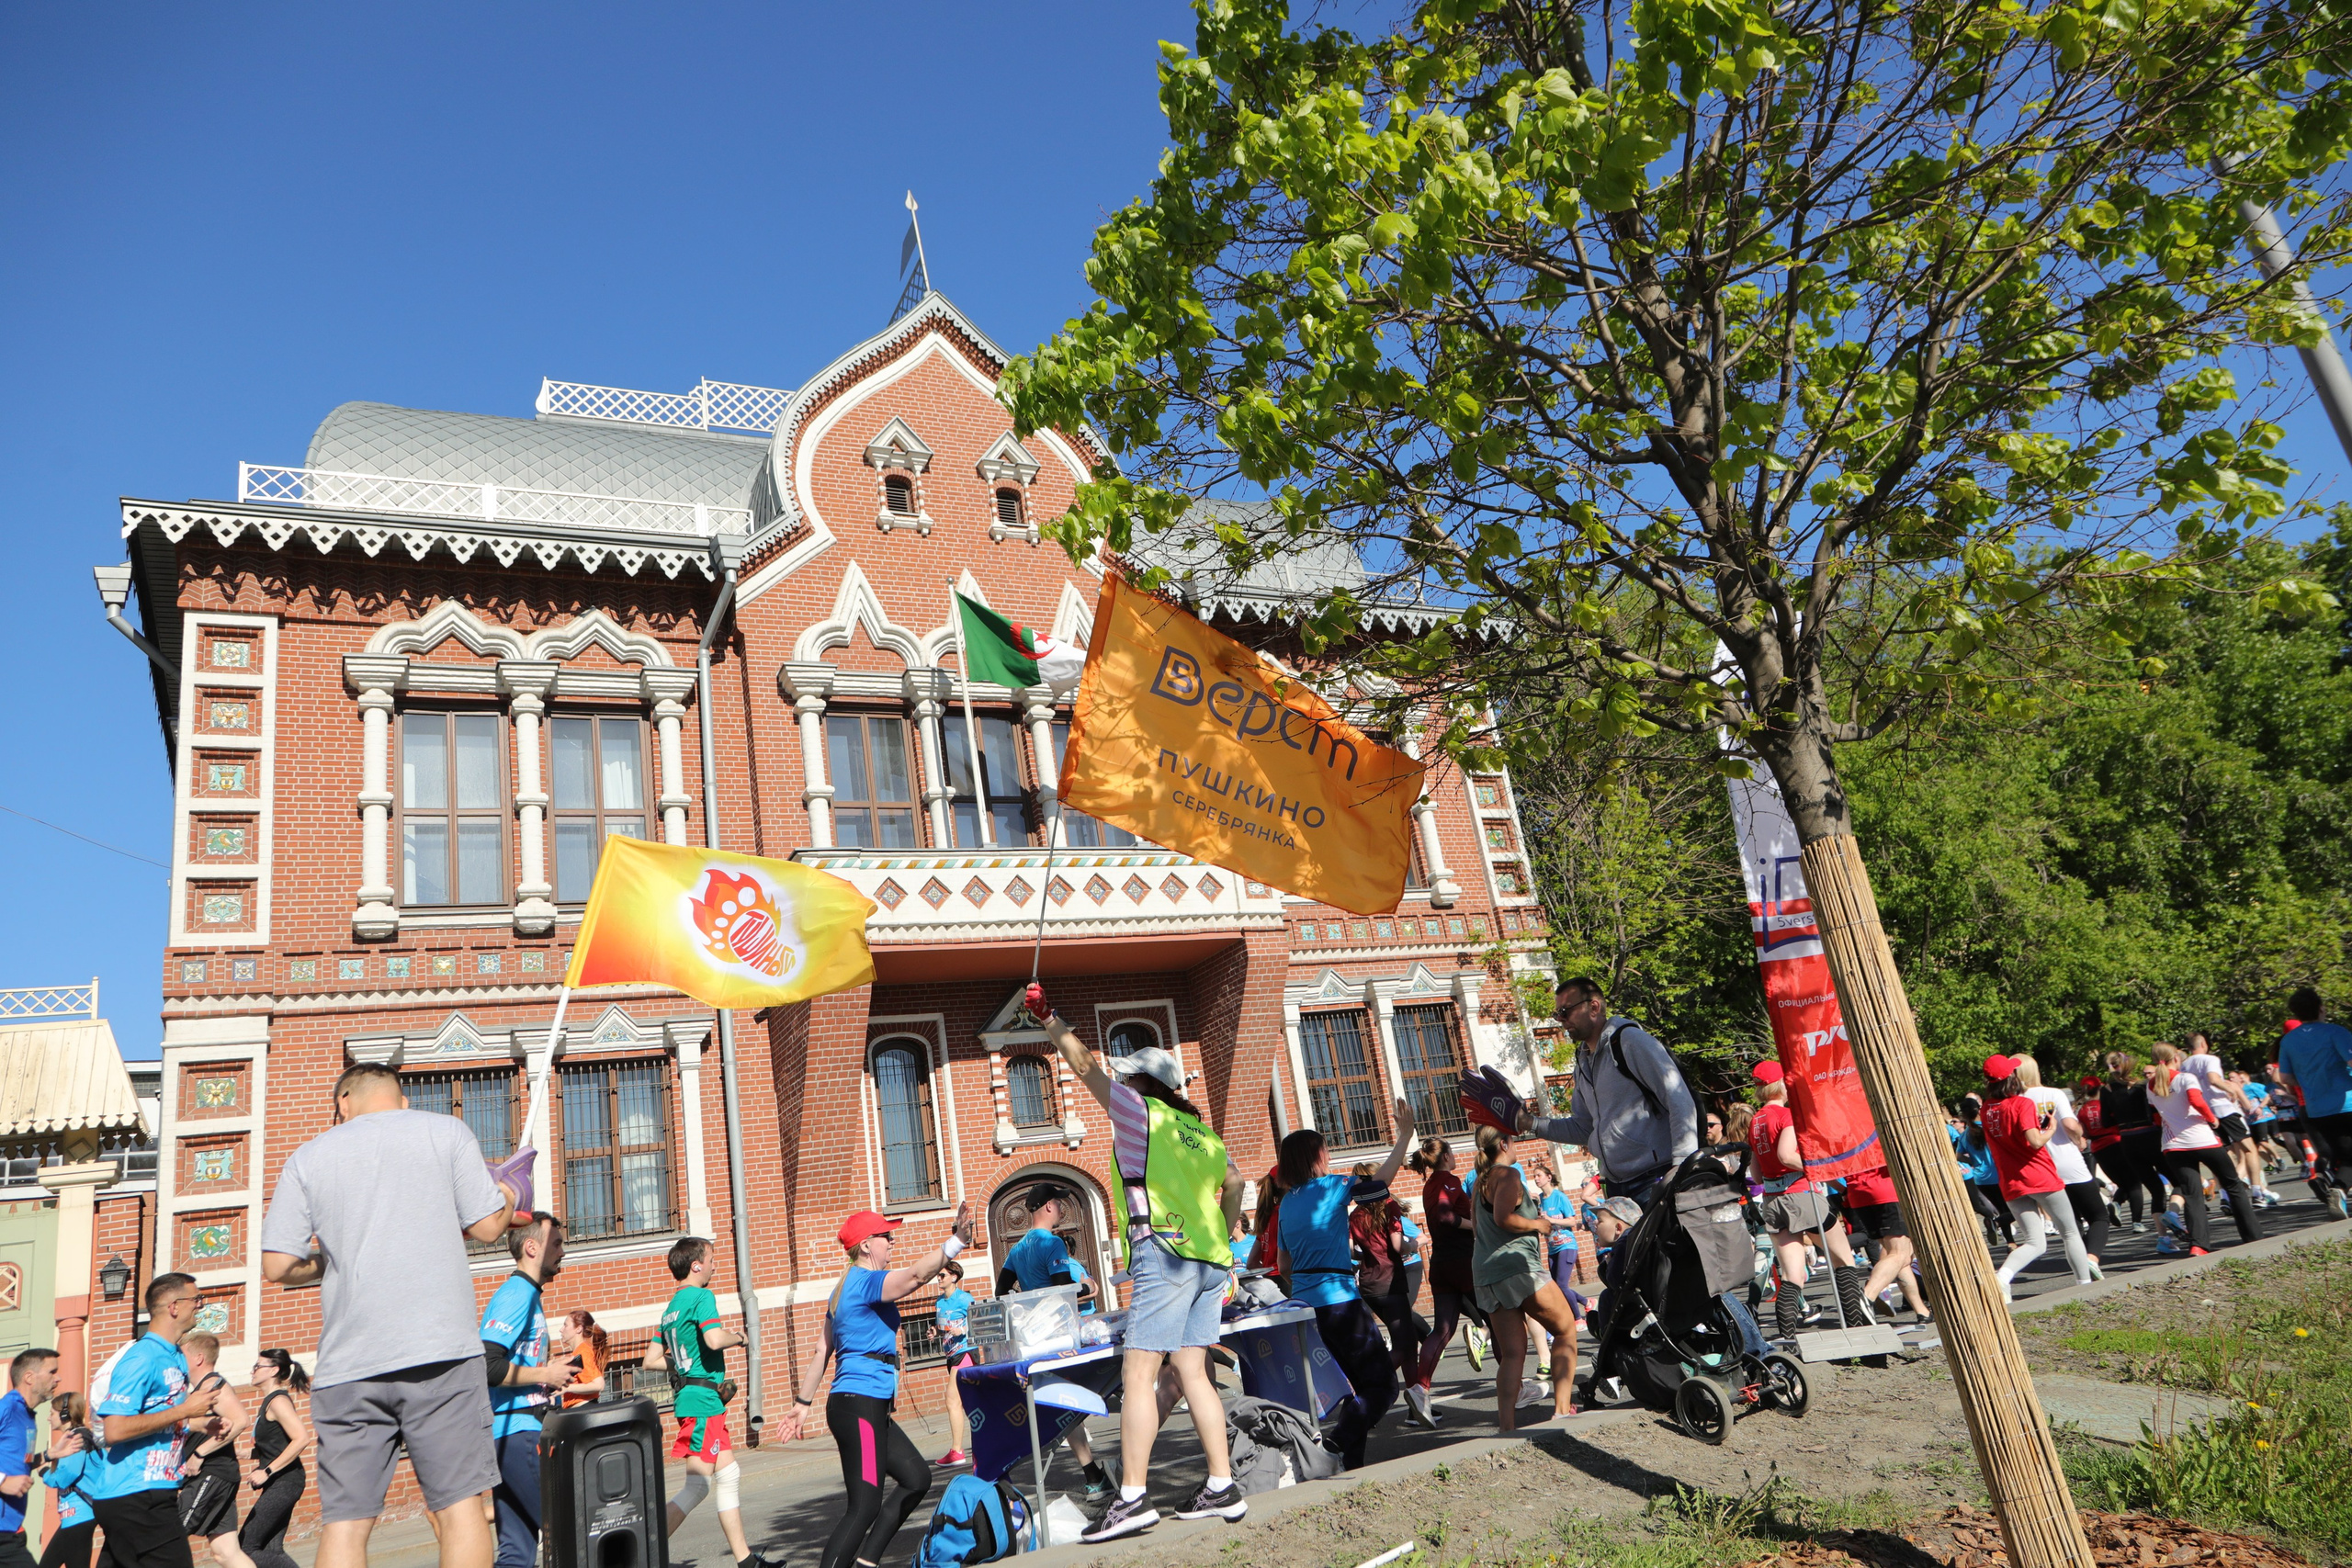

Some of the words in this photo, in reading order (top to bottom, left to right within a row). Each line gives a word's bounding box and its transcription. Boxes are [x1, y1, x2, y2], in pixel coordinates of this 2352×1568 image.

[1159, 748, 1326, 829] ПУШКИНО
[1172, 789, 1296, 851] СЕРЕБРЯНКА
[1777, 914, 1816, 928] 5vers
[1814, 1071, 1827, 1082] ОАО
